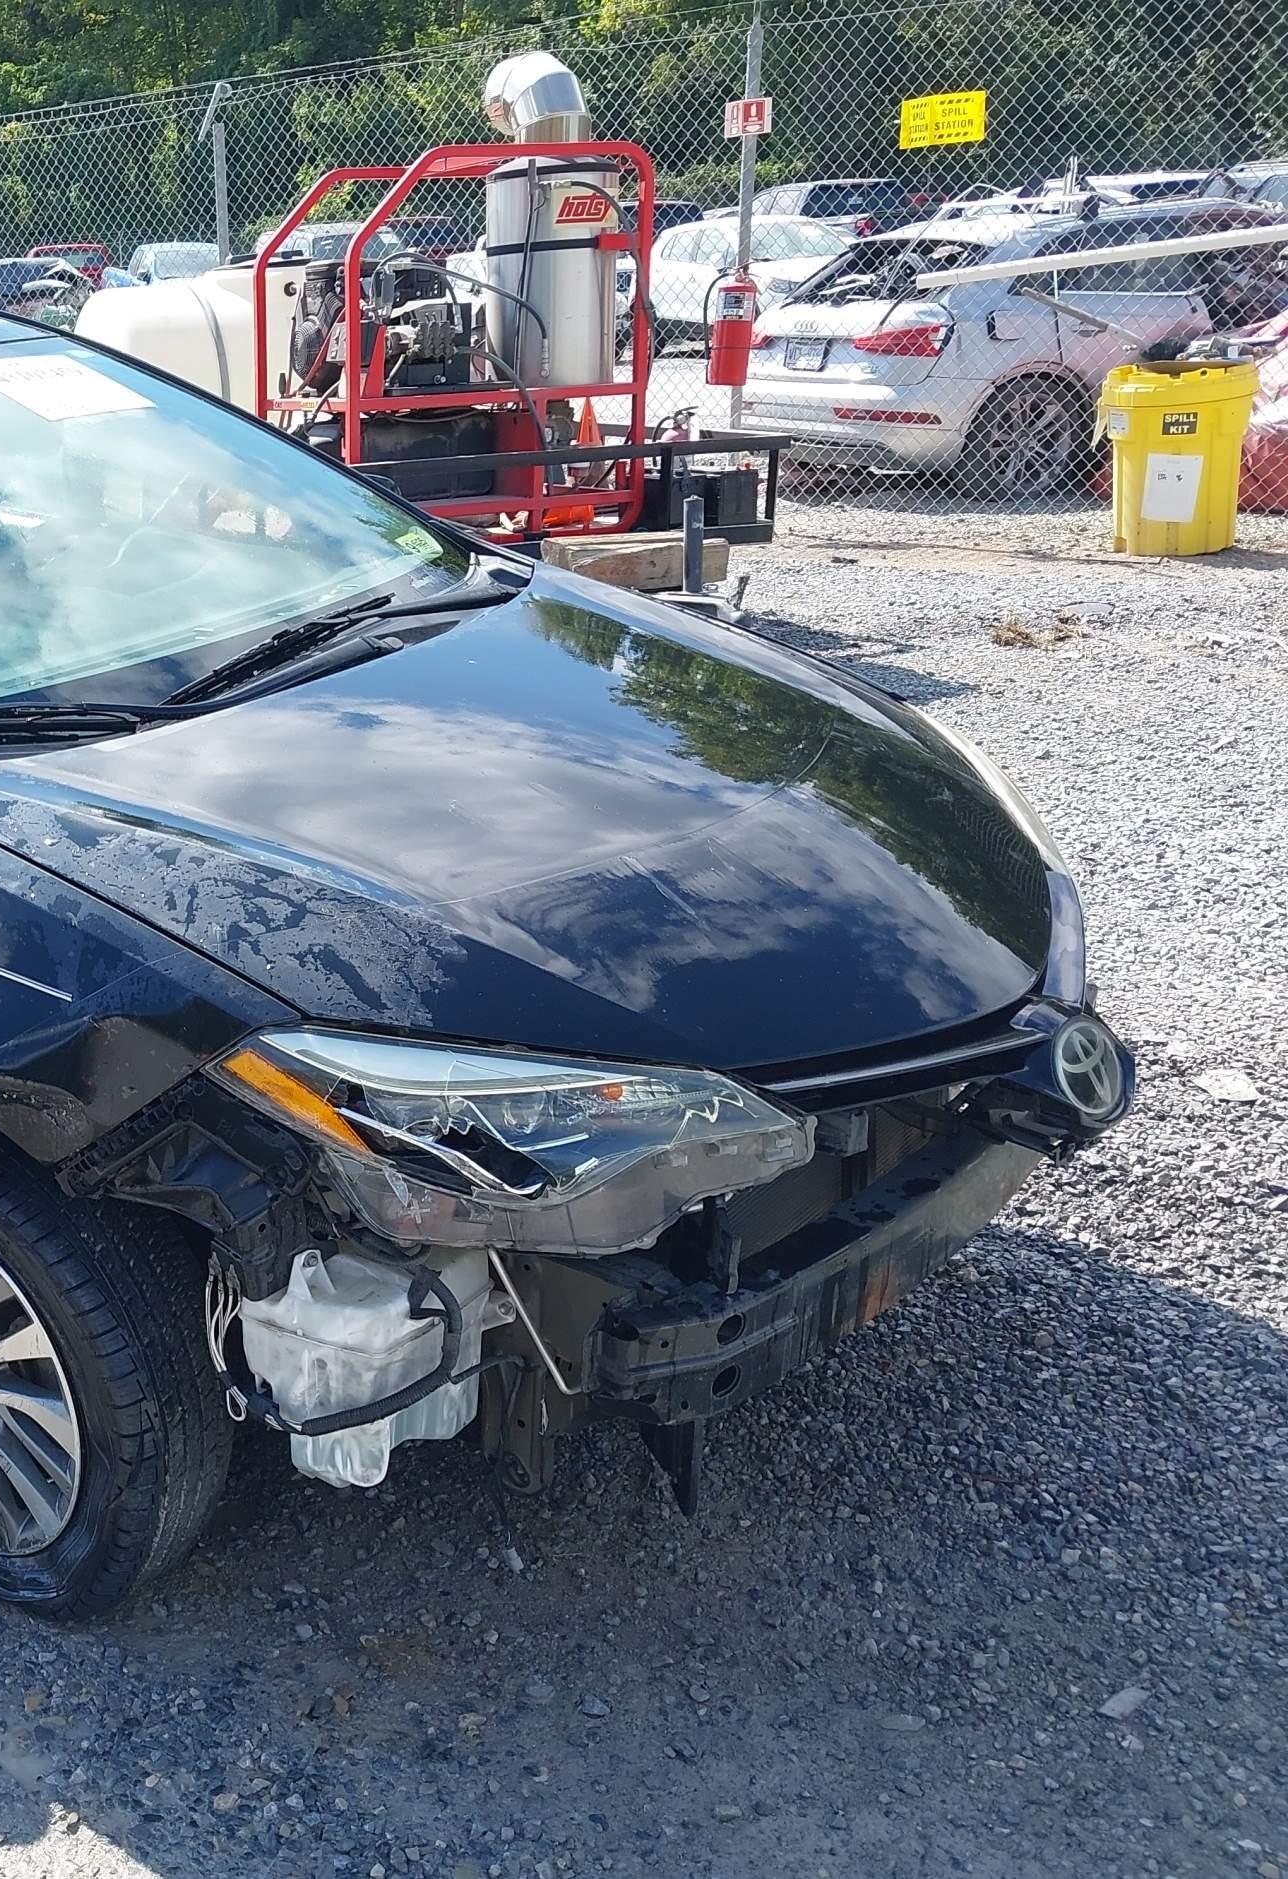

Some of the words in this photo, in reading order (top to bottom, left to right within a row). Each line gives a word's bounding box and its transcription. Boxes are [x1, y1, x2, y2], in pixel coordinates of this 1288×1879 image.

[941, 107, 968, 118] SPILL
[934, 118, 974, 131] STATION
[1164, 413, 1197, 423] SPILL
[1169, 425, 1191, 434] KIT
